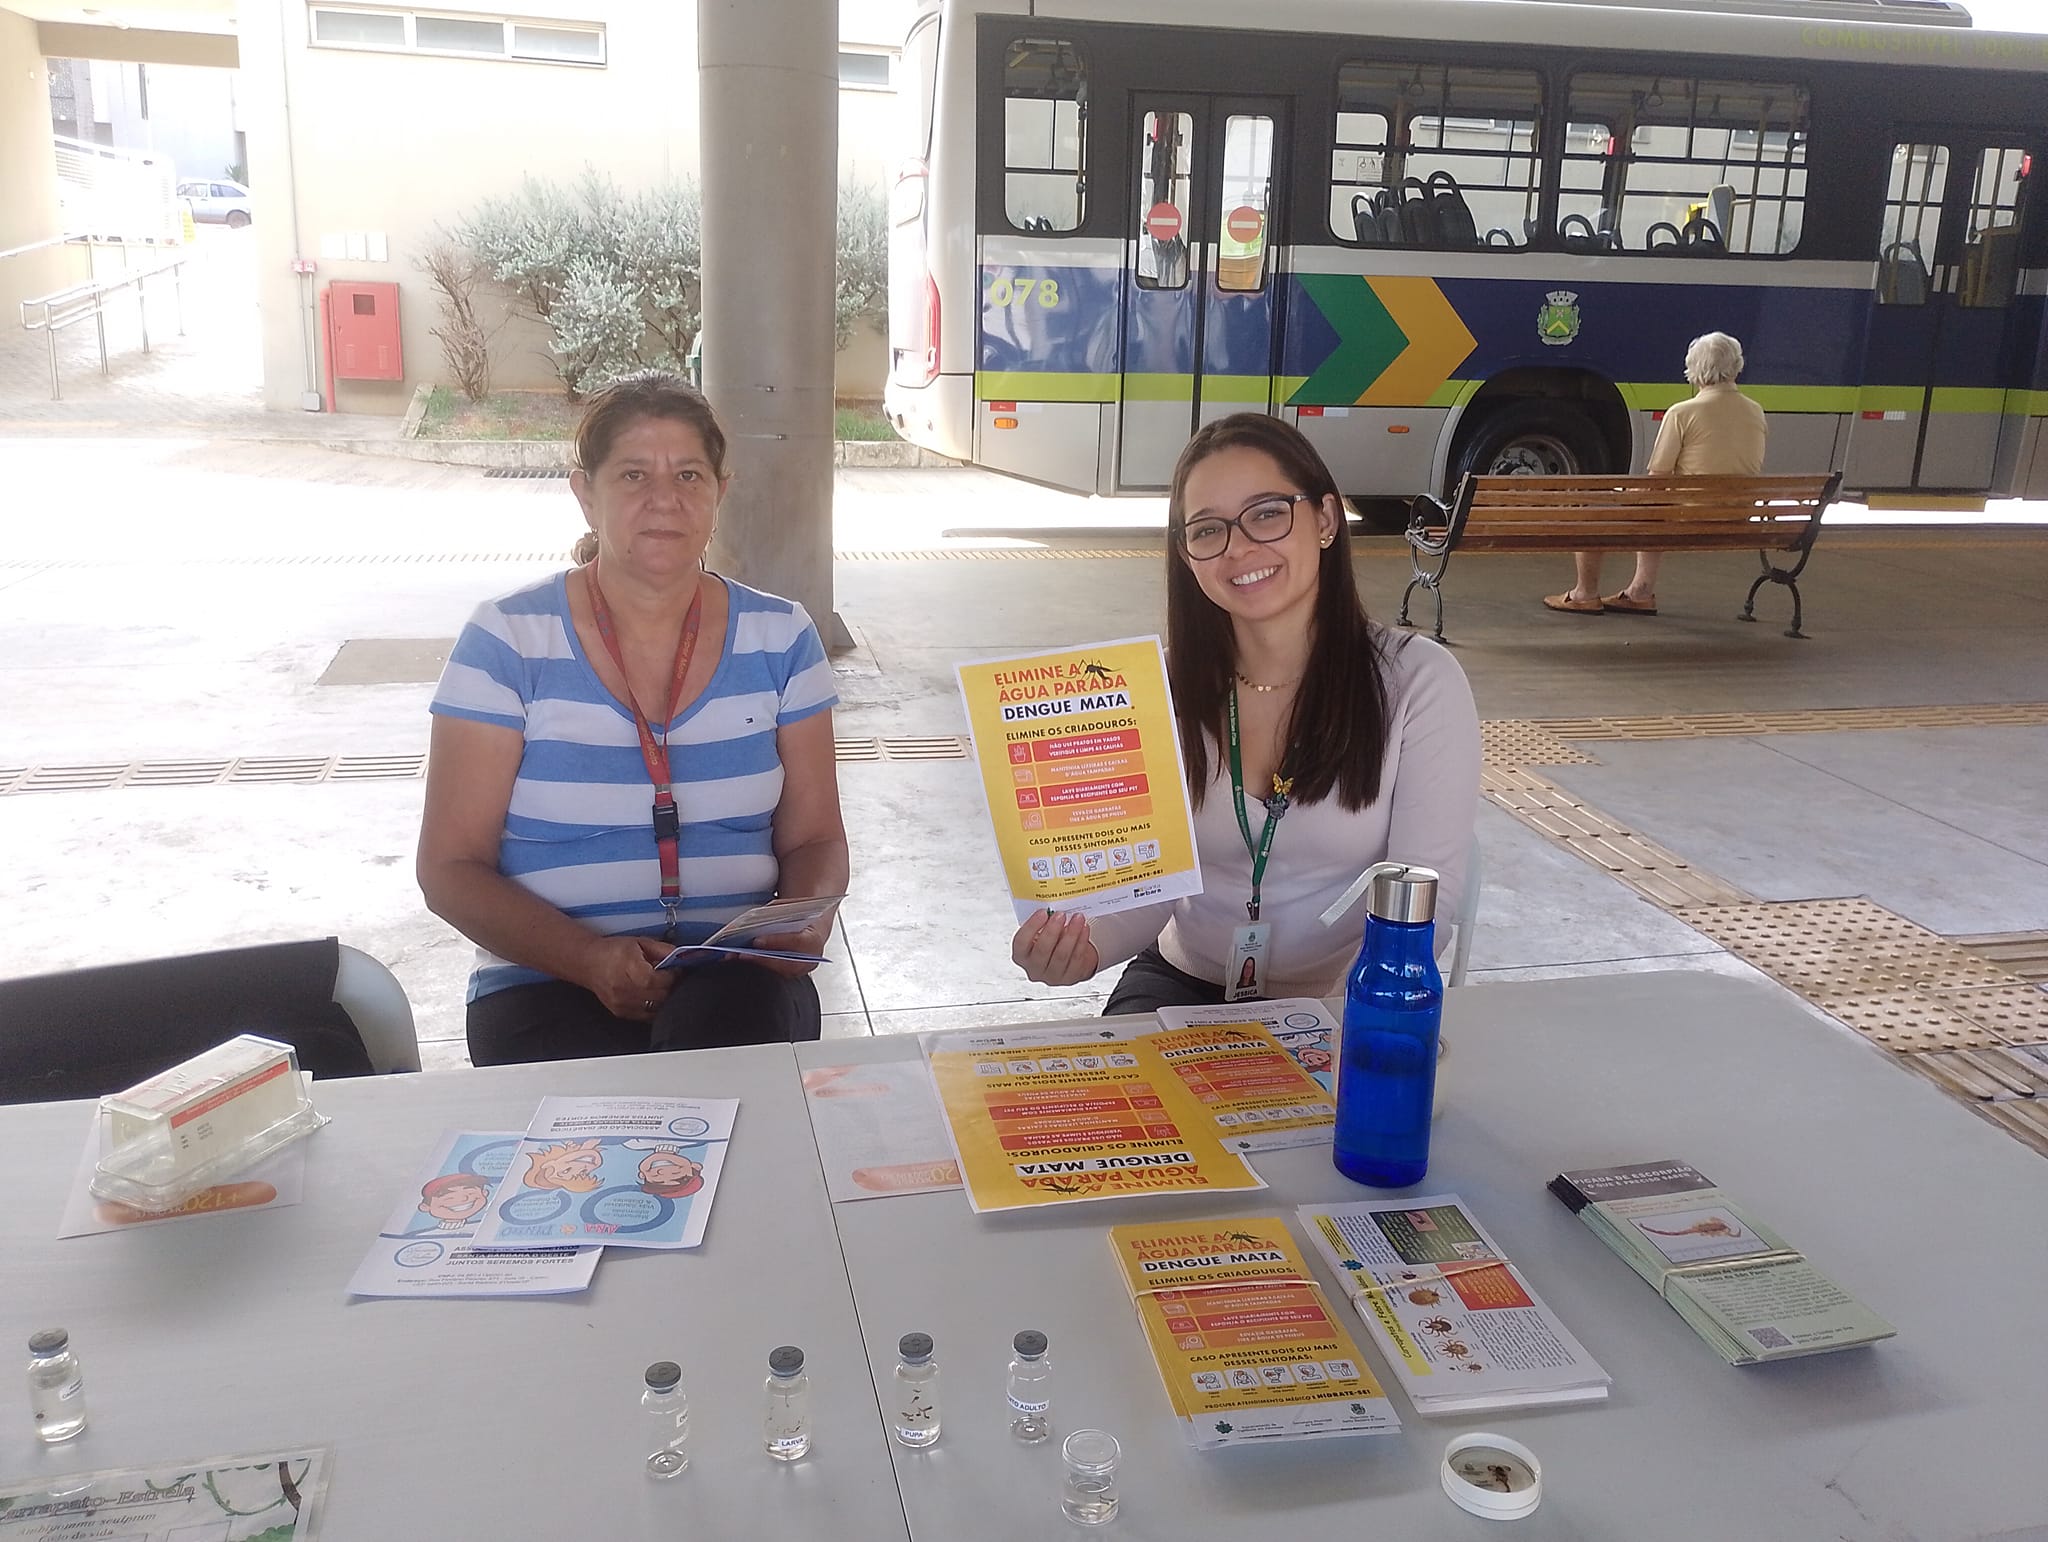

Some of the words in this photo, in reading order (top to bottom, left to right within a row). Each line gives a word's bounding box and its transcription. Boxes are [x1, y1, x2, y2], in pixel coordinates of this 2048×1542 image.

[990, 278, 1060, 308] 078
[994, 665, 1063, 685] ELIMINE
[1069, 664, 1080, 676] A
[1000, 685, 1049, 702] ÁGUA
[1054, 675, 1127, 696] PARADA
[1005, 701, 1072, 720] DENGUE
[1081, 694, 1127, 710] MATA
[1006, 728, 1045, 741] ELIMINE
[1048, 727, 1062, 736] OS
[1065, 718, 1137, 733] CRIADOUROS:
[1052, 832, 1093, 843] APRESENTE
[1095, 830, 1114, 838] DOIS
[1131, 823, 1151, 832] MAIS
[1055, 845, 1081, 853] DESSES
[1084, 837, 1127, 848] SINTOMAS:
[1151, 1031, 1211, 1045] ELIMINE
[1164, 1046, 1221, 1058] DENGUE
[1228, 1041, 1267, 1049] MATA
[1170, 1057, 1204, 1066] ELIMINE
[1058, 1075, 1110, 1083] APRESENTE
[1007, 1143, 1104, 1158] CRIADOUROS:
[1107, 1142, 1126, 1150] OS
[1131, 1139, 1184, 1149] ELIMINE
[1020, 1161, 1084, 1175] MATA
[1096, 1152, 1191, 1169] DENGUE
[1021, 1173, 1123, 1189] PARADA
[1110, 1176, 1209, 1190] ELIMINE
[1574, 1176, 1614, 1185] PICADA
[1631, 1167, 1692, 1179] ESCORPIÃO
[1130, 1234, 1207, 1249] ELIMINE
[1214, 1233, 1226, 1241] A
[1198, 1240, 1279, 1255] PARADA
[1145, 1256, 1222, 1271] DENGUE
[1230, 1251, 1282, 1262] MATA
[1149, 1275, 1195, 1286] ELIMINE
[1216, 1268, 1296, 1278] CRIADOUROS:
[1387, 1326, 1412, 1358] Carrapatos
[1219, 1349, 1270, 1360] APRESENTE
[1272, 1346, 1294, 1354] DOIS
[1297, 1345, 1311, 1353] OU
[1224, 1359, 1257, 1367] DESSES
[1259, 1354, 1312, 1364] SINTOMAS:
[1205, 1401, 1236, 1409] PROCURE
[1237, 1398, 1285, 1407] ATENDIMENTO
[1317, 1389, 1370, 1399] HIDRATE-SE!
[904, 1429, 924, 1439] PUPA
[781, 1438, 805, 1449] LARVA
